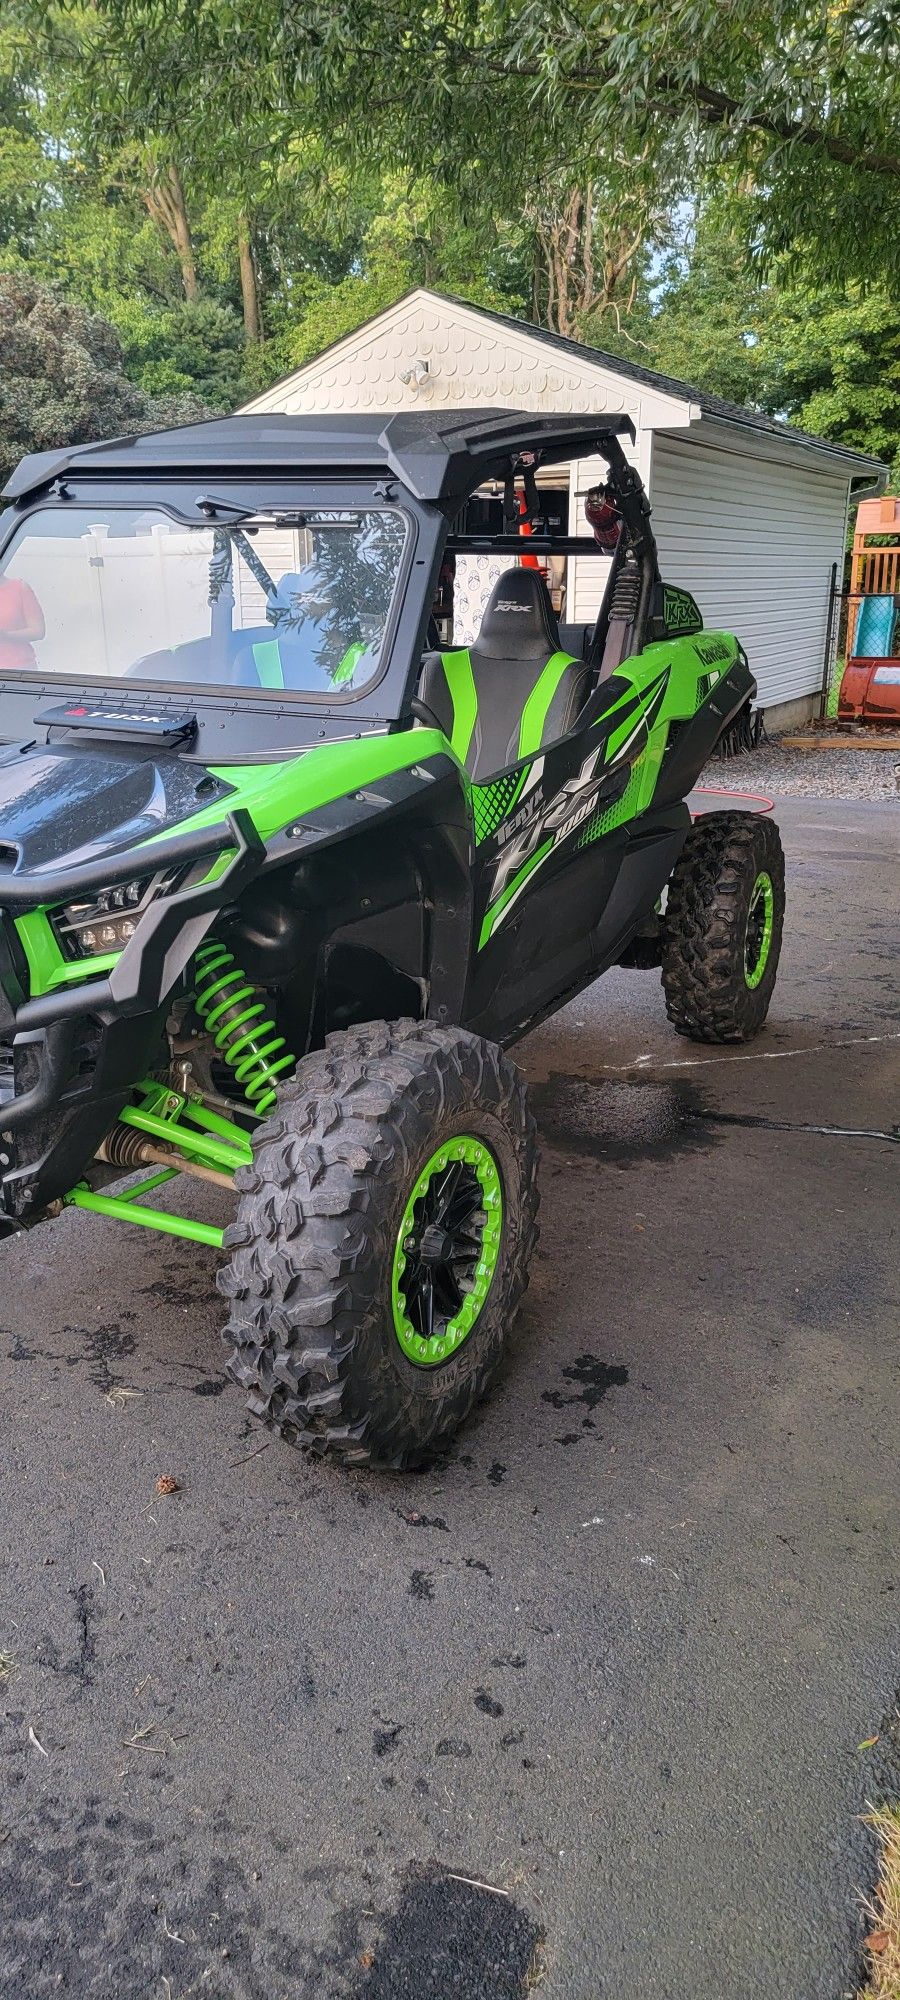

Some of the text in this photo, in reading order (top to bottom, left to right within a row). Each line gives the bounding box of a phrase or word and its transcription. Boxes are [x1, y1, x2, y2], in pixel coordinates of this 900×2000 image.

[493, 604, 534, 612] KRX
[87, 711, 170, 723] TUSK
[484, 736, 606, 905] KRX
[553, 791, 600, 845] 1000
